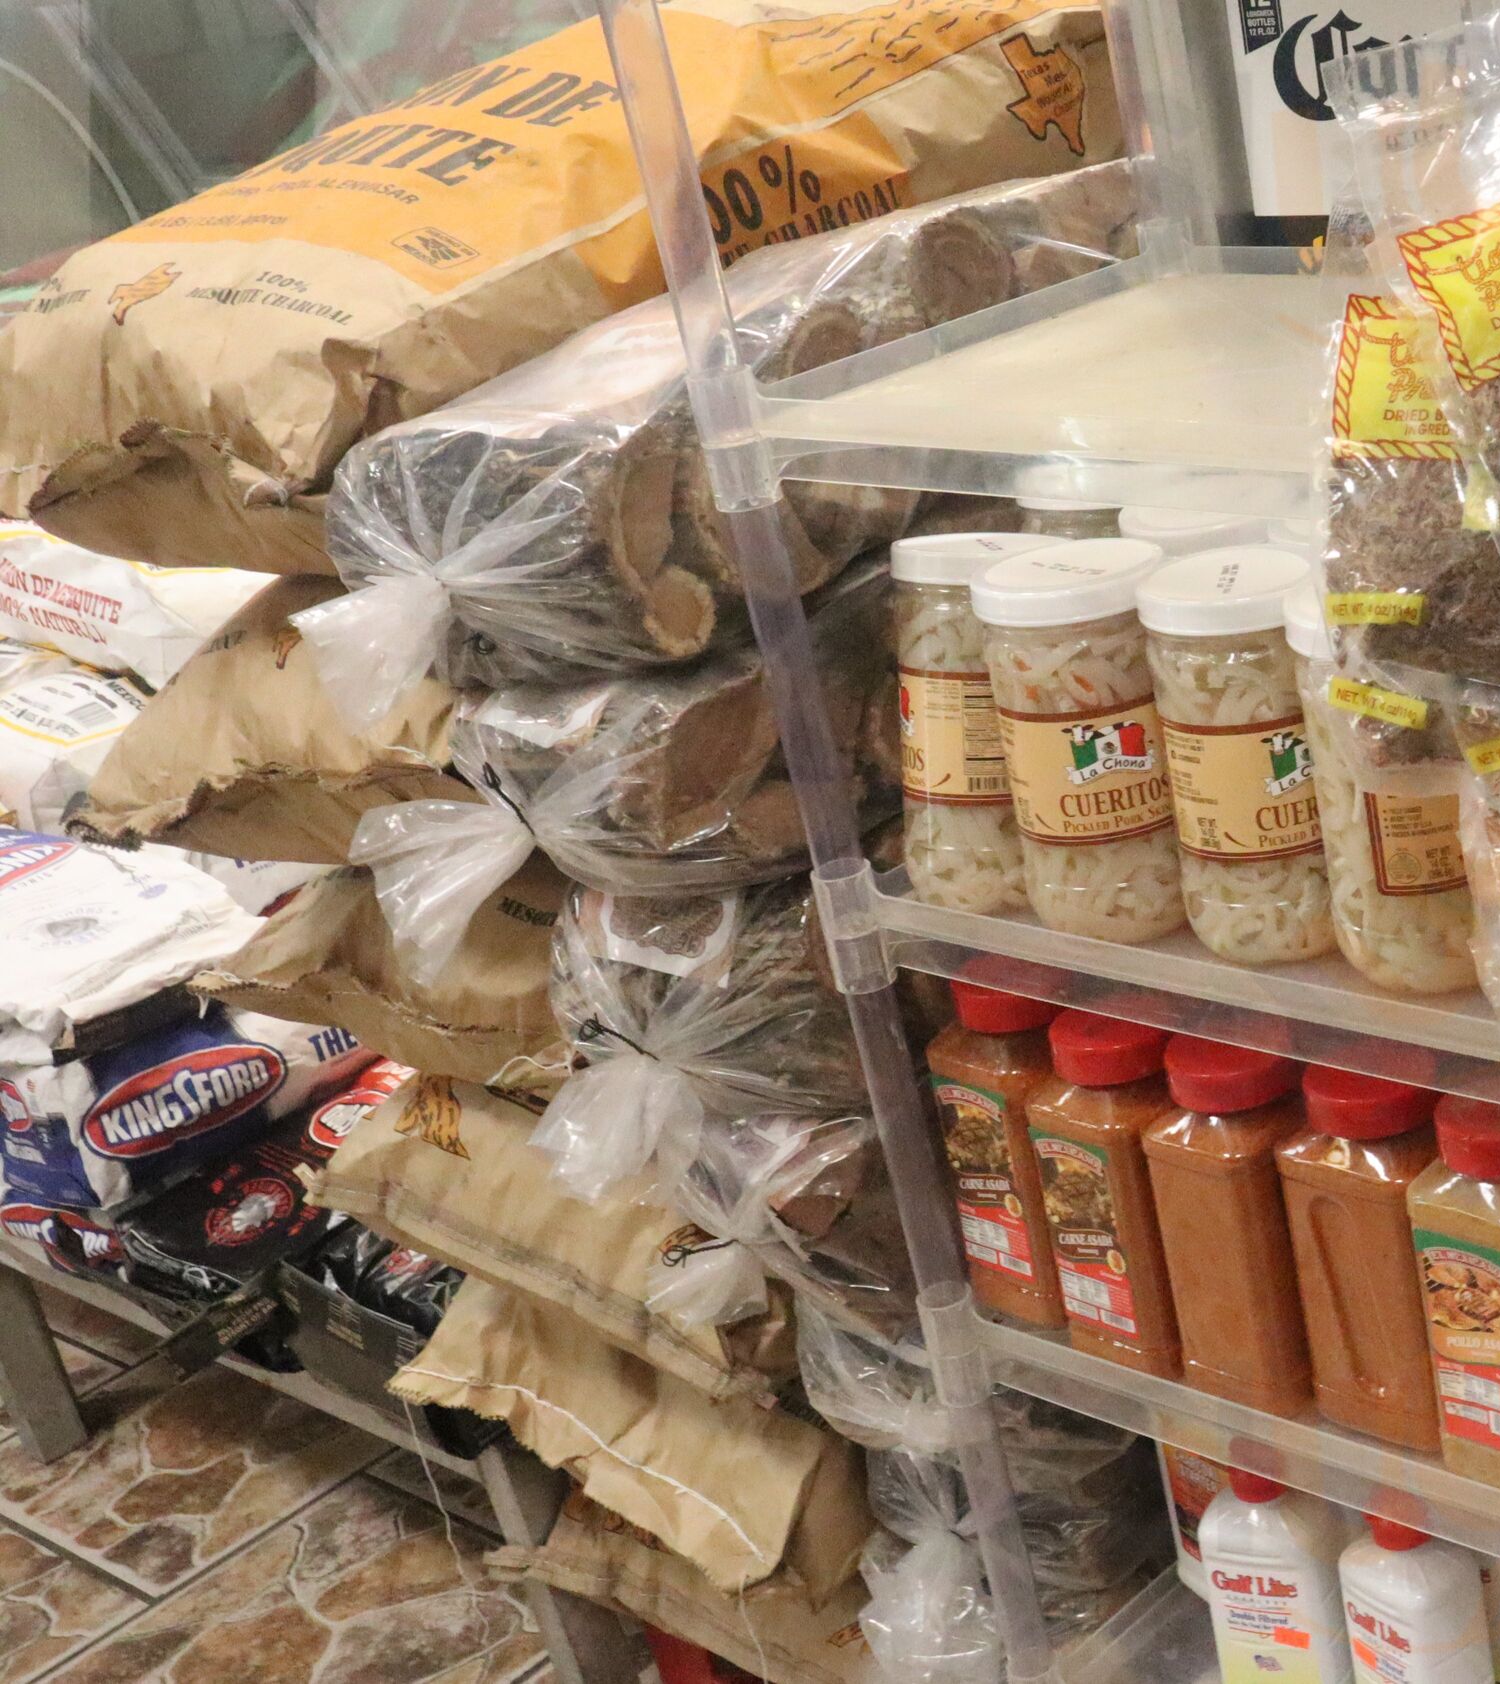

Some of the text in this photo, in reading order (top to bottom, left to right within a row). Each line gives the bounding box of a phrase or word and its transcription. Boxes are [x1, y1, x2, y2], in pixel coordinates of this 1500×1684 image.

[1247, 18, 1276, 27] BOTTLES
[482, 72, 620, 127] DE
[700, 144, 822, 244] 00%
[254, 270, 311, 294] 100%
[1383, 409, 1430, 422] DRIED
[1404, 423, 1451, 436] INGRED
[1080, 757, 1147, 782] La Chona
[1059, 772, 1171, 818] CUERITOS
[1278, 778, 1297, 792] La
[1256, 796, 1319, 832] CUER
[99, 1058, 271, 1145] KINGSFORD
[1211, 1570, 1298, 1599] Gulf Lite
